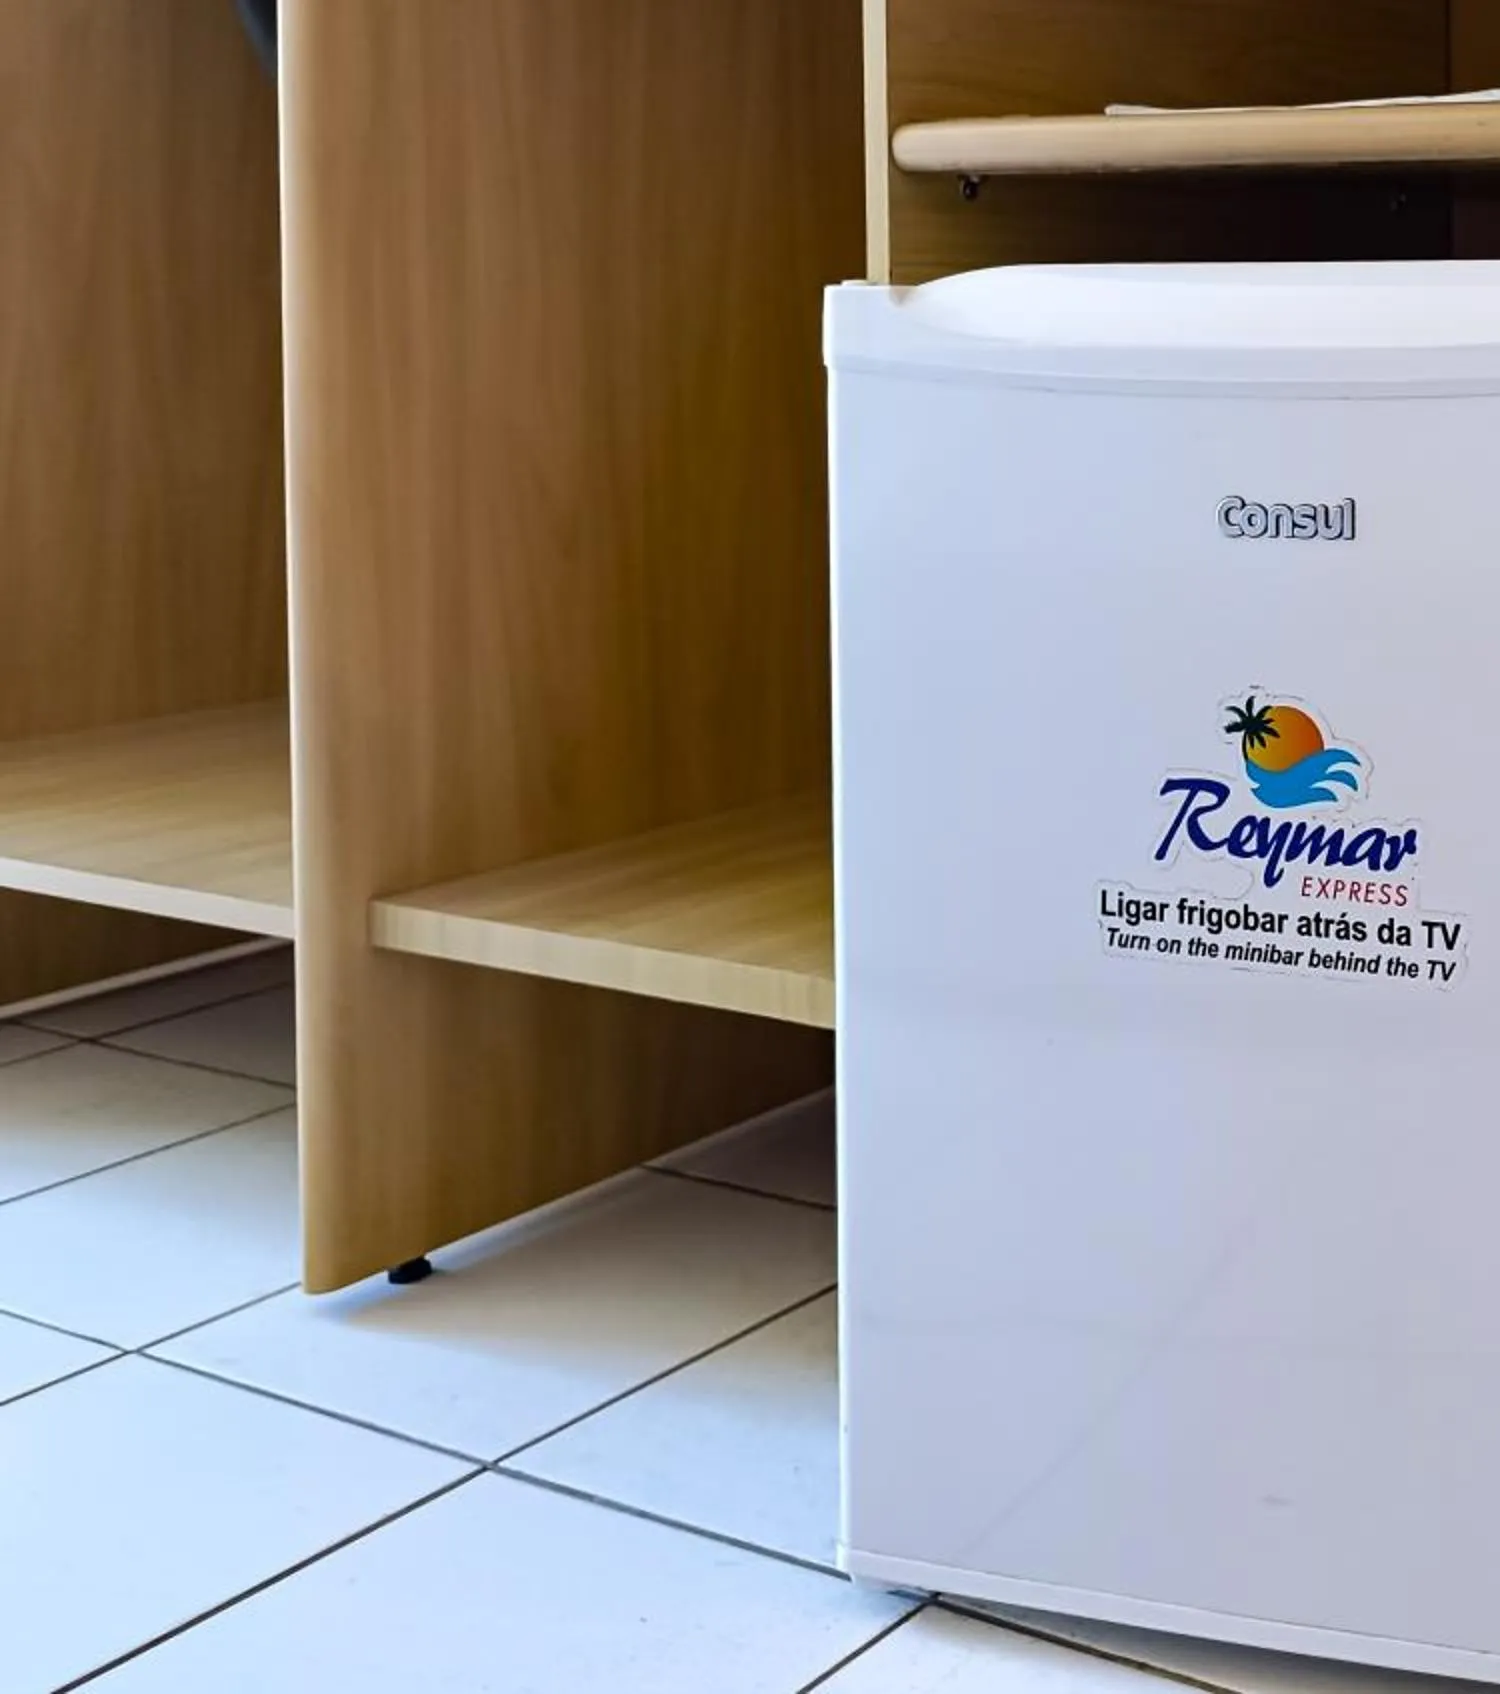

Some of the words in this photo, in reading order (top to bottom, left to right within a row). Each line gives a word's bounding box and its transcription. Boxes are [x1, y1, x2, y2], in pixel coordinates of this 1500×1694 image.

[1216, 495, 1356, 540] Consul
[1154, 778, 1418, 887] Reymar
[1301, 876, 1409, 907] EXPRESS
[1100, 889, 1170, 926] Ligar
[1176, 898, 1289, 935] frigobar
[1296, 912, 1367, 942] atrás
[1377, 917, 1412, 947] da
[1421, 920, 1461, 951] TV
[1107, 927, 1151, 951] Turn
[1156, 937, 1182, 955] on
[1187, 937, 1219, 958] the
[1224, 942, 1304, 967] minibar
[1308, 948, 1381, 975] behind
[1385, 956, 1419, 979] the
[1427, 959, 1457, 982] TV
